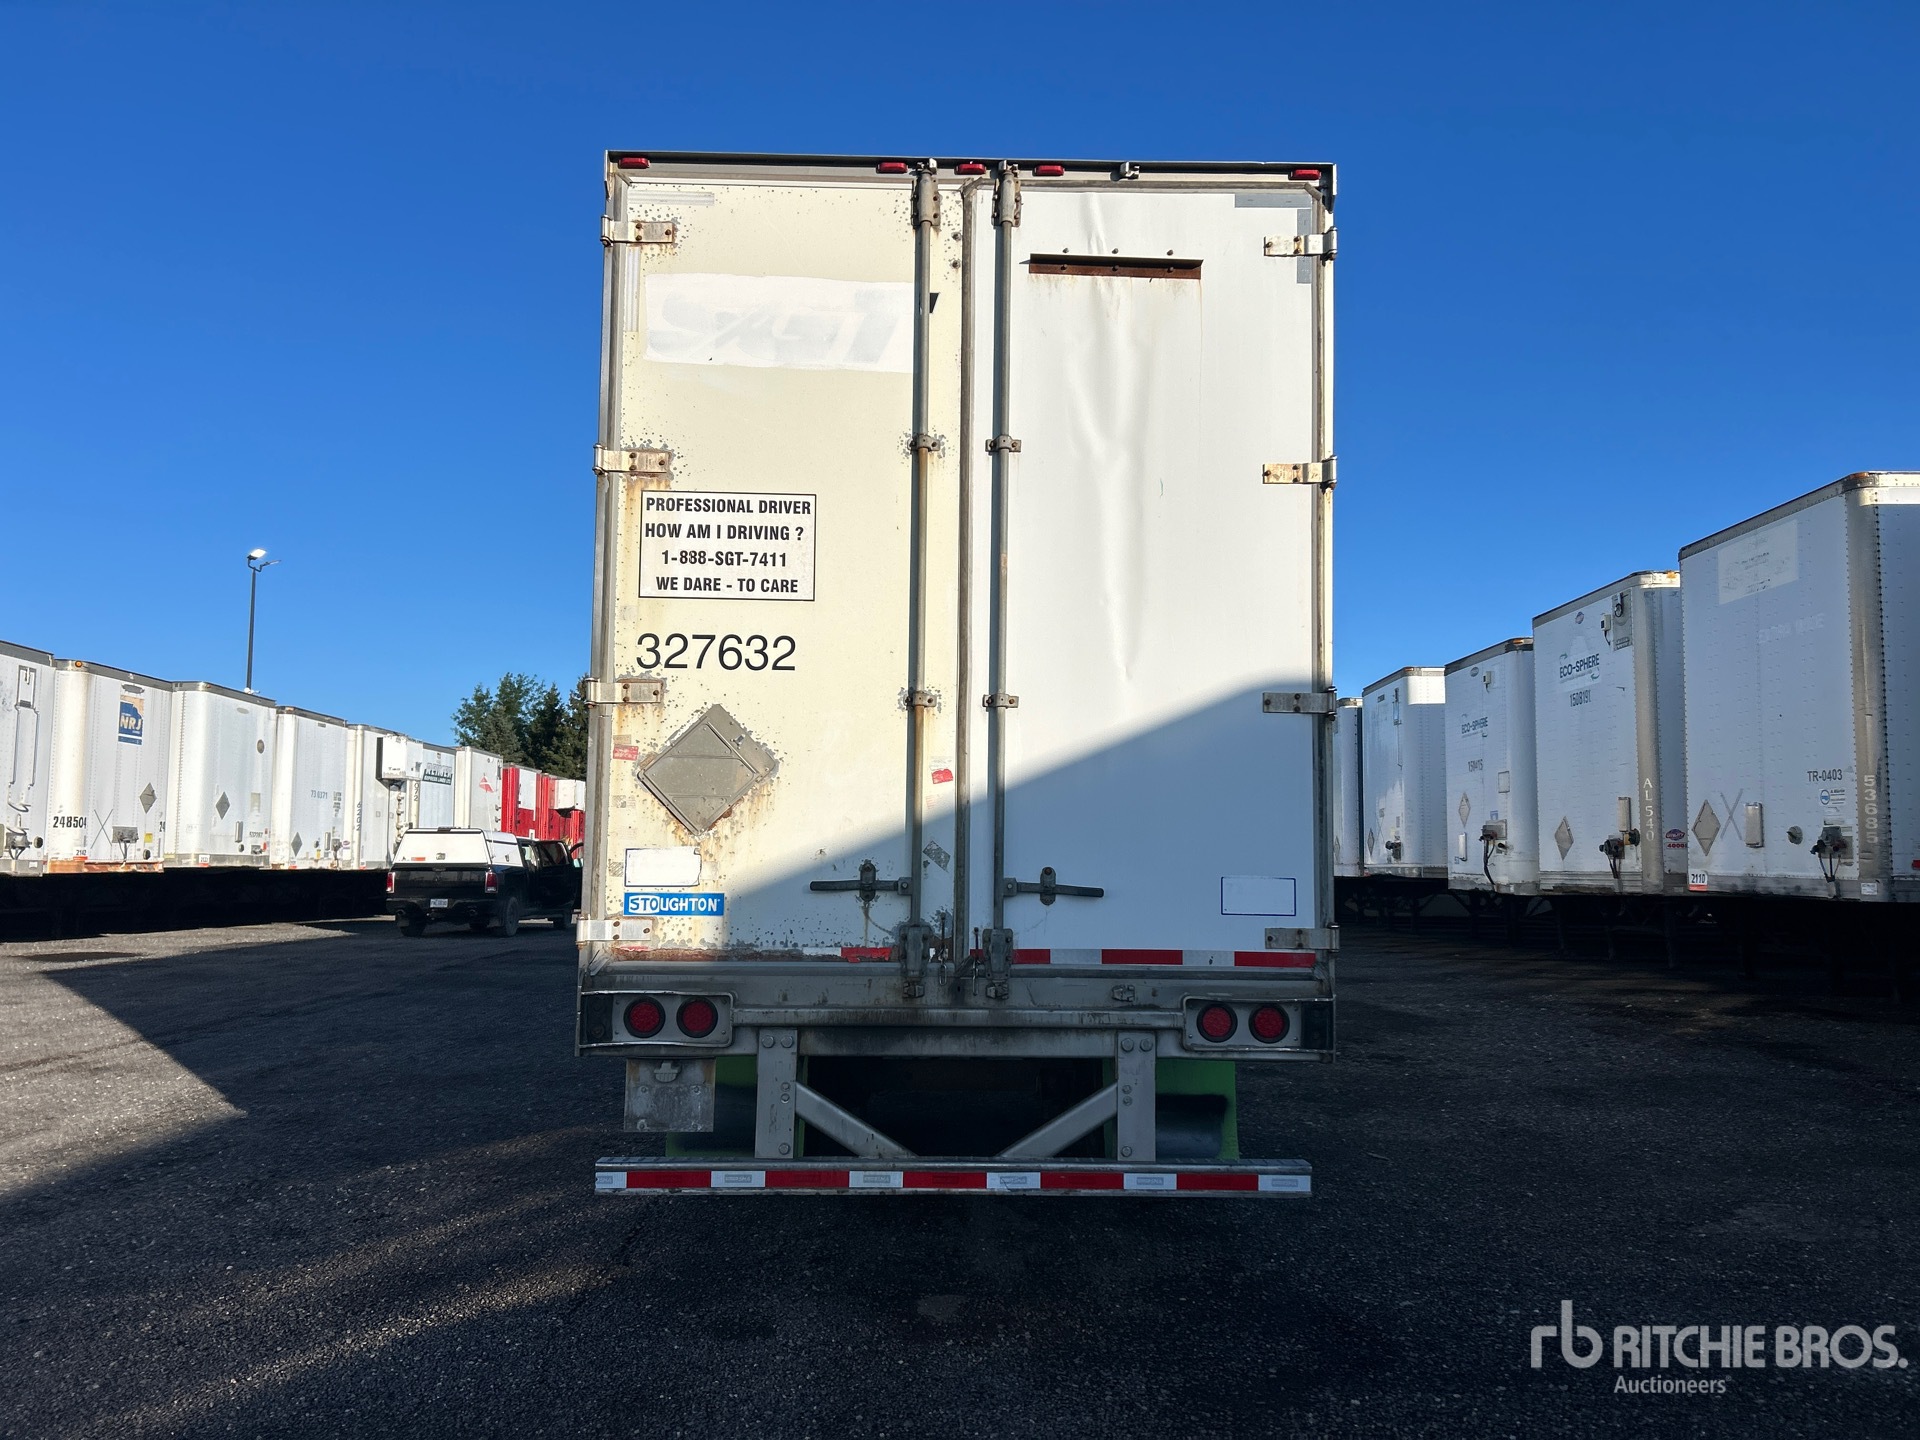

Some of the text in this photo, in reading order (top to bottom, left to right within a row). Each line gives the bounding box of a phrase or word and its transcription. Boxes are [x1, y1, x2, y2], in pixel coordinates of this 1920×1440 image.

[646, 497, 811, 514] PROFESSIONAL DRIVER
[645, 523, 804, 541] HOW AM I DRIVING ?
[661, 550, 787, 567] 1-888-SGT-7411
[656, 576, 678, 591] WE
[683, 577, 721, 591] DARE
[737, 578, 756, 592] TO
[760, 579, 798, 593] CARE
[636, 632, 796, 671] 327632
[1559, 653, 1600, 679] ECO-SPHERE
[1807, 768, 1843, 782] TR-0403
[1864, 774, 1879, 844] 53685
[630, 897, 718, 912] STOUGHTON
